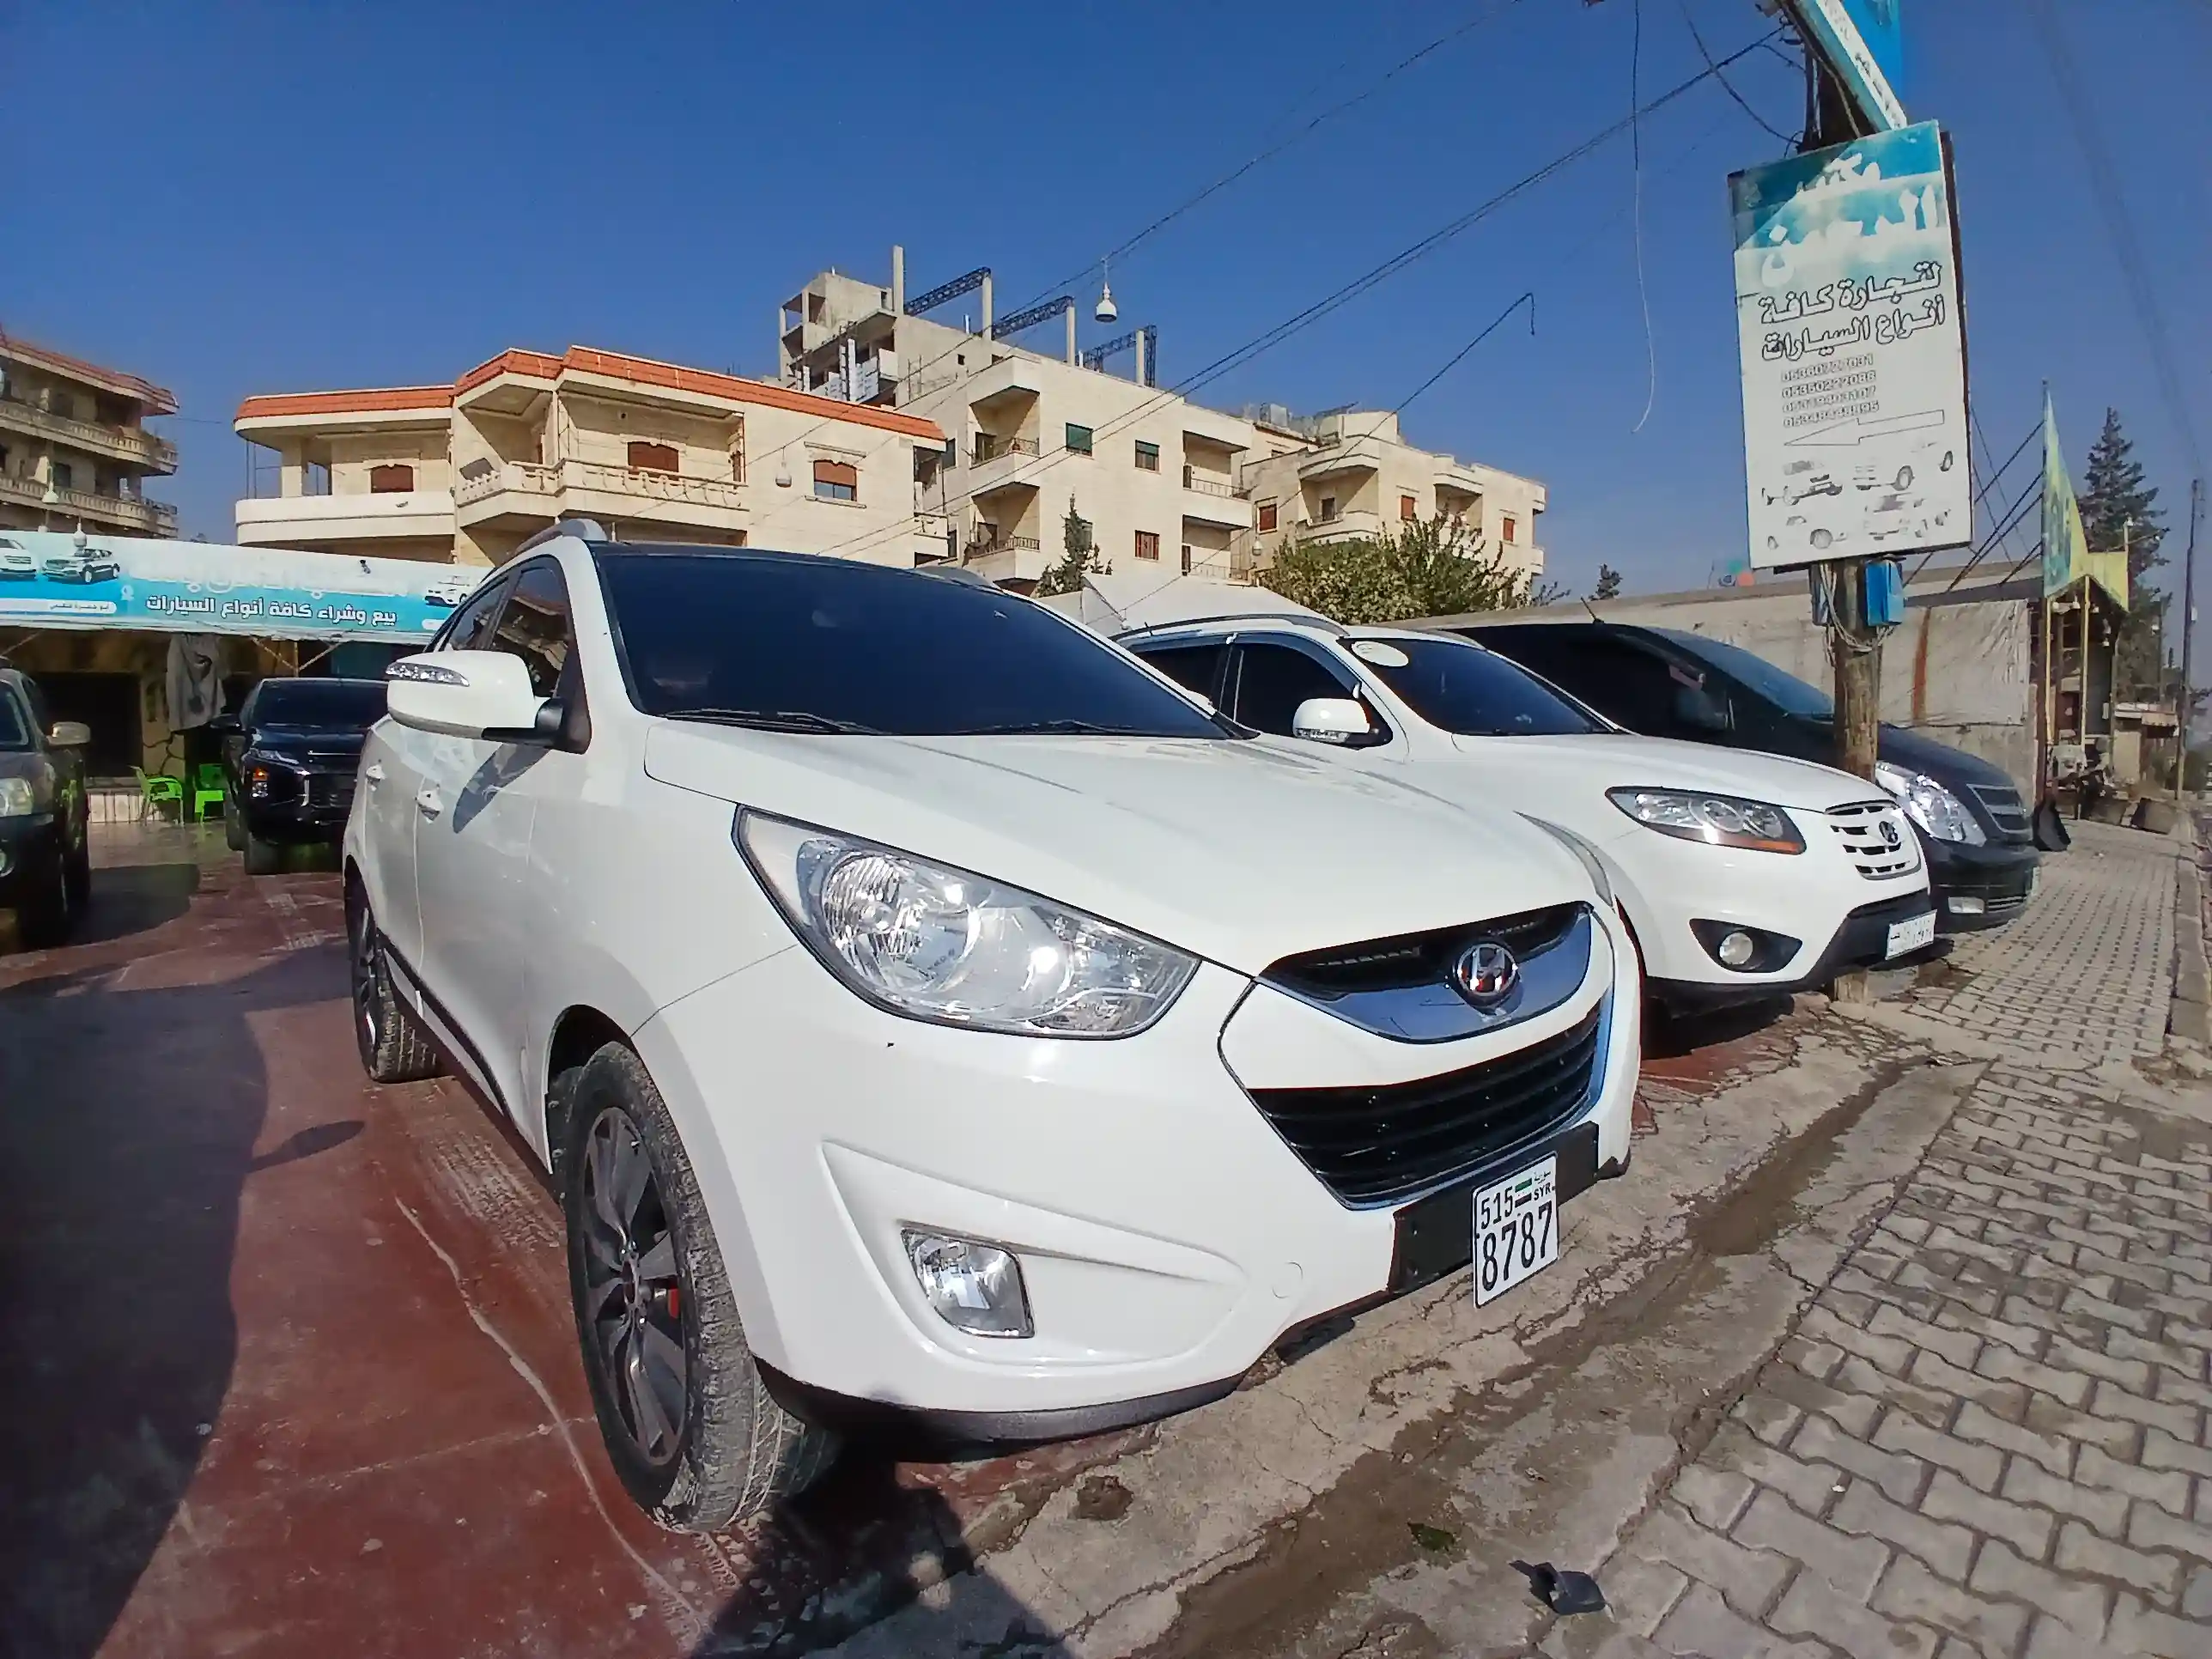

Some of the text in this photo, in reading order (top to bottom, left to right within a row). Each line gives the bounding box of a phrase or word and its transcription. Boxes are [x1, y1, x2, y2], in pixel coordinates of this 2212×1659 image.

[1758, 260, 1942, 324] لتجارة كافة
[1762, 315, 1870, 361] السيارات
[146, 595, 398, 626] بيع وشراء كافة أنواع السيارات
[1480, 1186, 1513, 1229] 515
[1534, 1182, 1551, 1200] SYR
[1482, 1200, 1552, 1291] 8787
